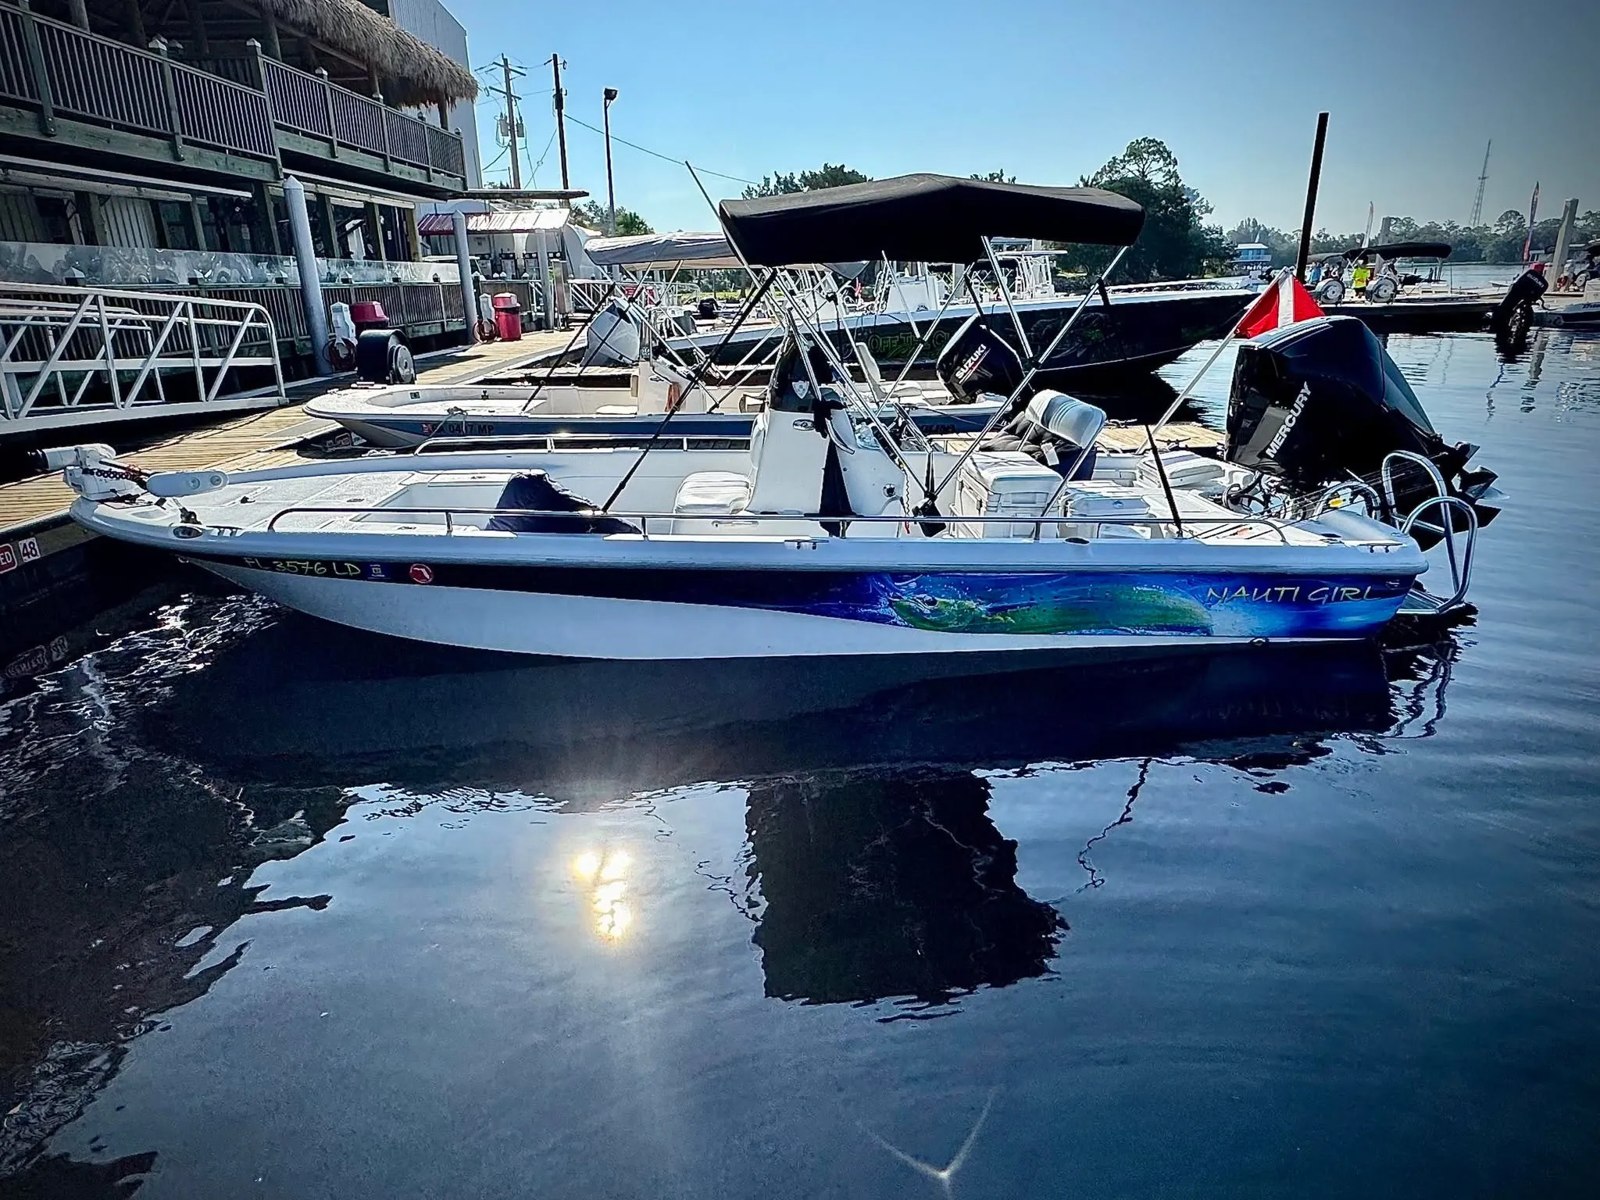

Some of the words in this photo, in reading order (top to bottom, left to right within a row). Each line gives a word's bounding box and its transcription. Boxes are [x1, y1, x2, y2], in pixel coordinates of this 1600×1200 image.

[955, 343, 987, 379] SUZUKI
[478, 424, 494, 434] MP
[1265, 381, 1311, 458] MERCURY
[22, 541, 38, 559] 48
[243, 557, 271, 570] FL
[272, 560, 327, 576] 3576
[332, 566, 361, 577] LD
[1206, 585, 1300, 605] NAUTI
[1307, 585, 1382, 605] GIRL
